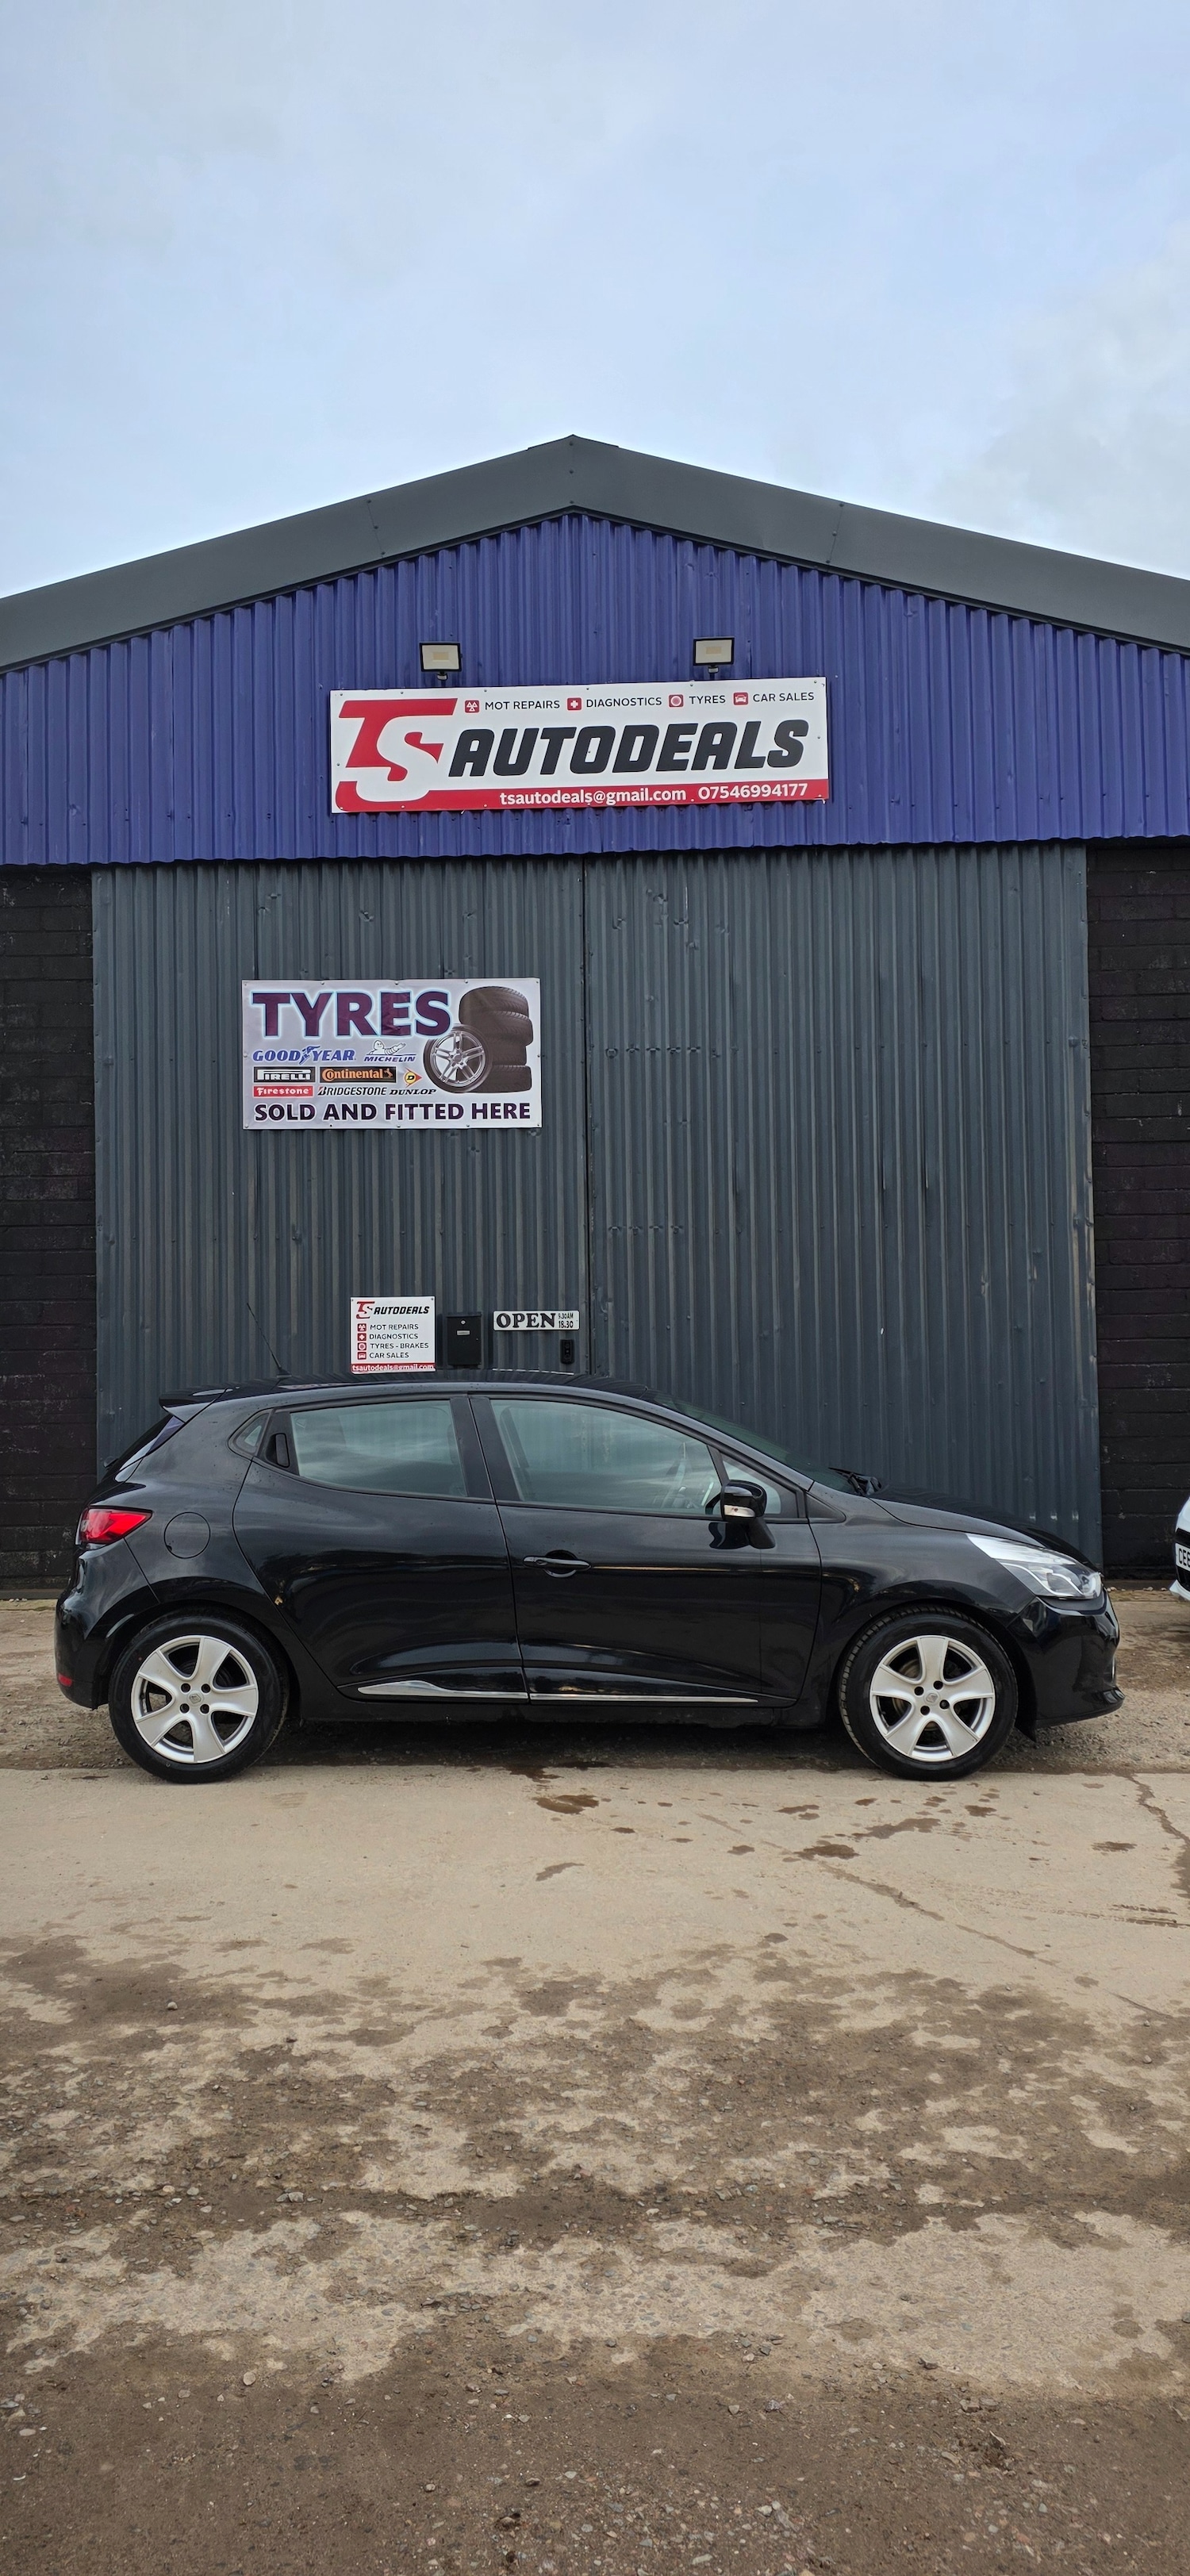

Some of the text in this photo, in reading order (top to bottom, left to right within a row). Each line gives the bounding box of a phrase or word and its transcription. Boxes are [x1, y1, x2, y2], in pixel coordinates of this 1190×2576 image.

[585, 697, 662, 708] DIAGNOSTICS
[689, 695, 726, 705] TYRES
[753, 692, 815, 702] CAR SALES
[485, 700, 560, 711] MOT REPAIRS
[448, 720, 809, 777] AUTODEALS
[500, 783, 808, 805] tsautodeals@gmail.com 07546994177
[252, 991, 451, 1037] TYRES
[257, 1069, 311, 1080] PIRELLI
[322, 1068, 383, 1082] Continental
[256, 1087, 309, 1096] Firestone
[317, 1086, 387, 1096] BRIDGESTONE
[255, 1103, 531, 1121] SOLD AND FITTED HERE
[374, 1306, 430, 1315] AUTODEALS
[496, 1312, 556, 1328] OPEN
